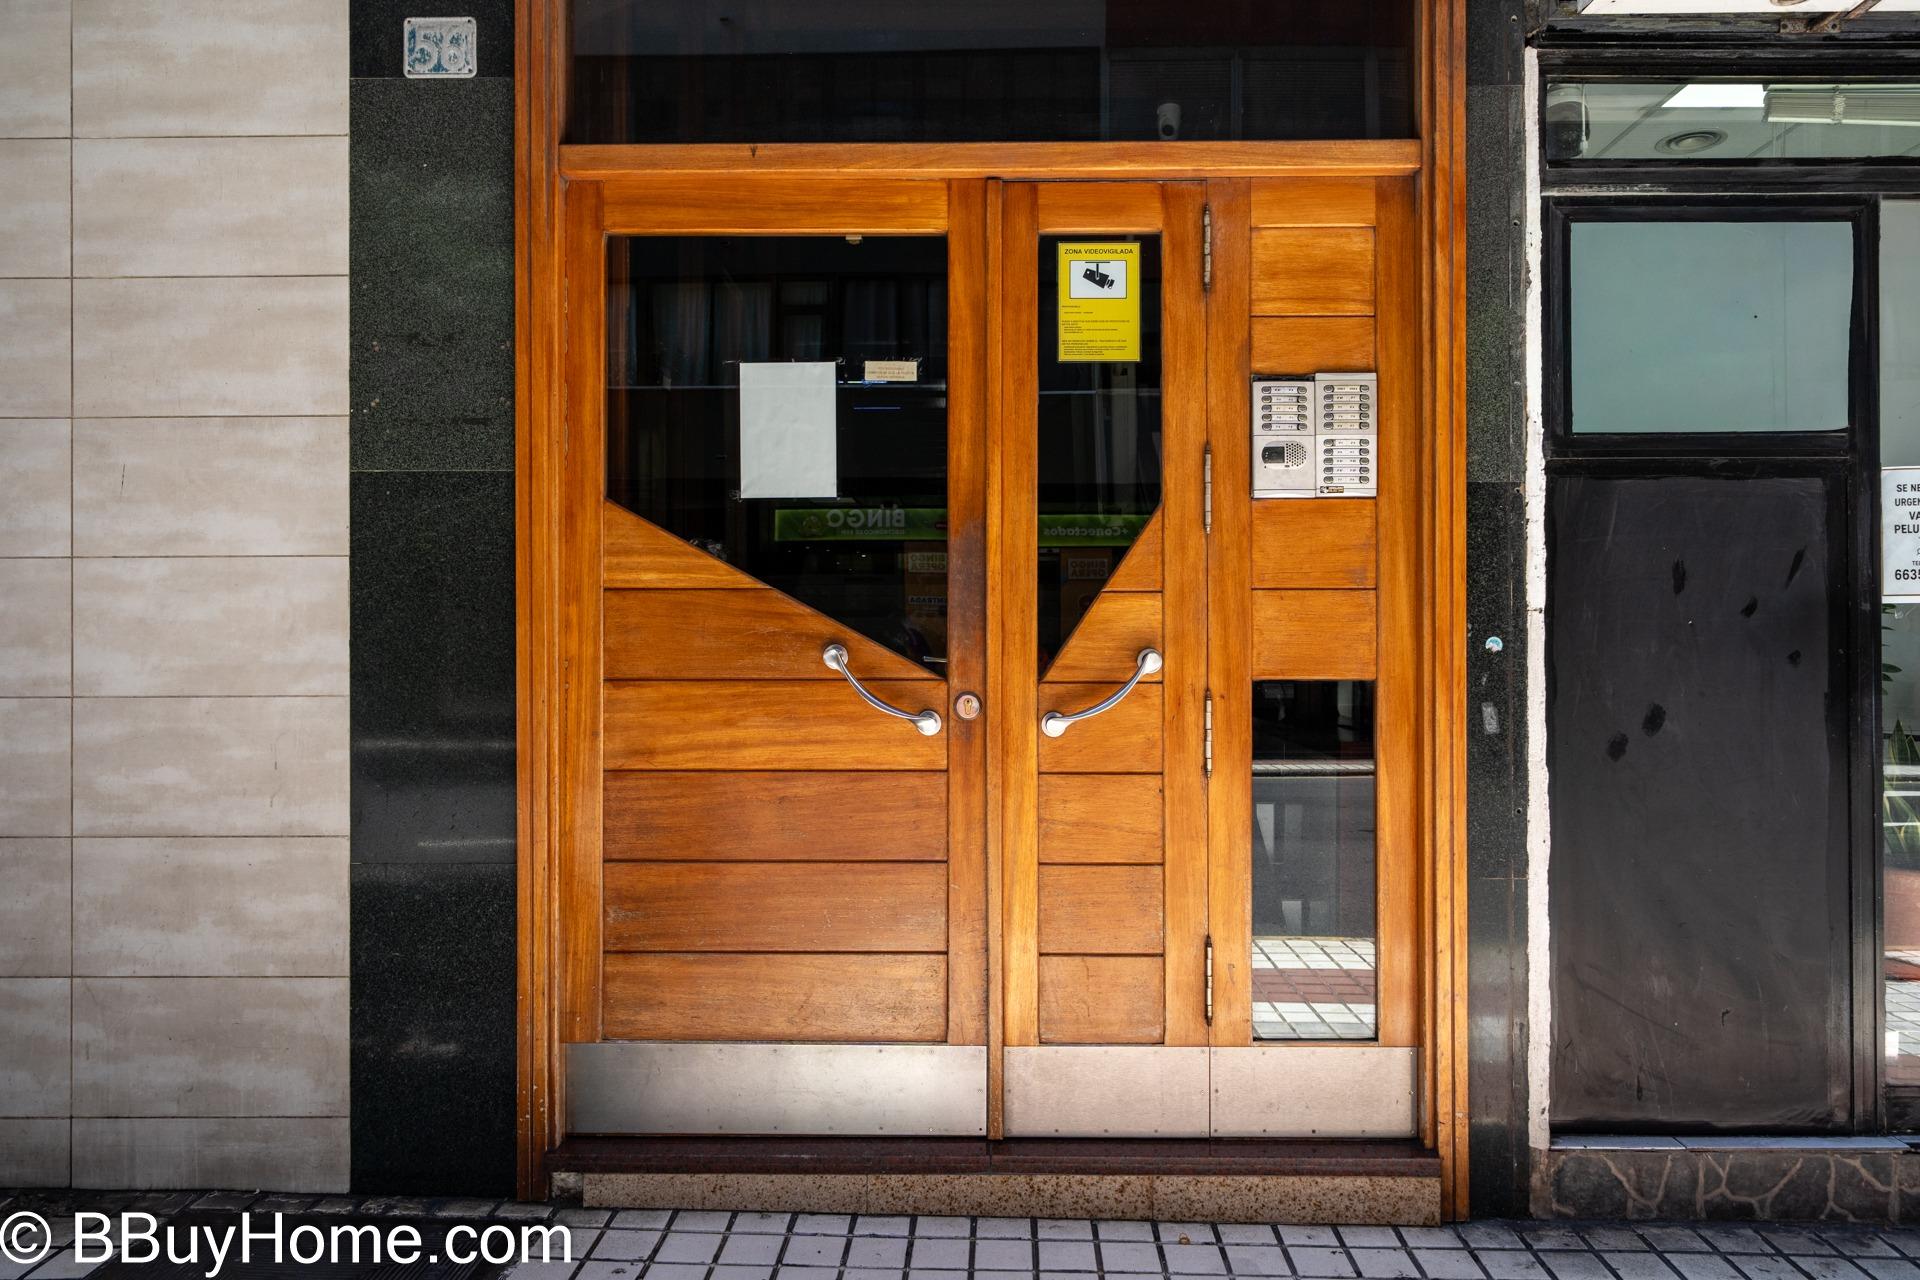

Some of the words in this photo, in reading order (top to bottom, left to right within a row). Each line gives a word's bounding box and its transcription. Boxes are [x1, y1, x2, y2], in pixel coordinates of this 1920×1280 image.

[1896, 484, 1907, 493] SE
[1894, 524, 1920, 534] PELU
[1894, 569, 1920, 580] 663
